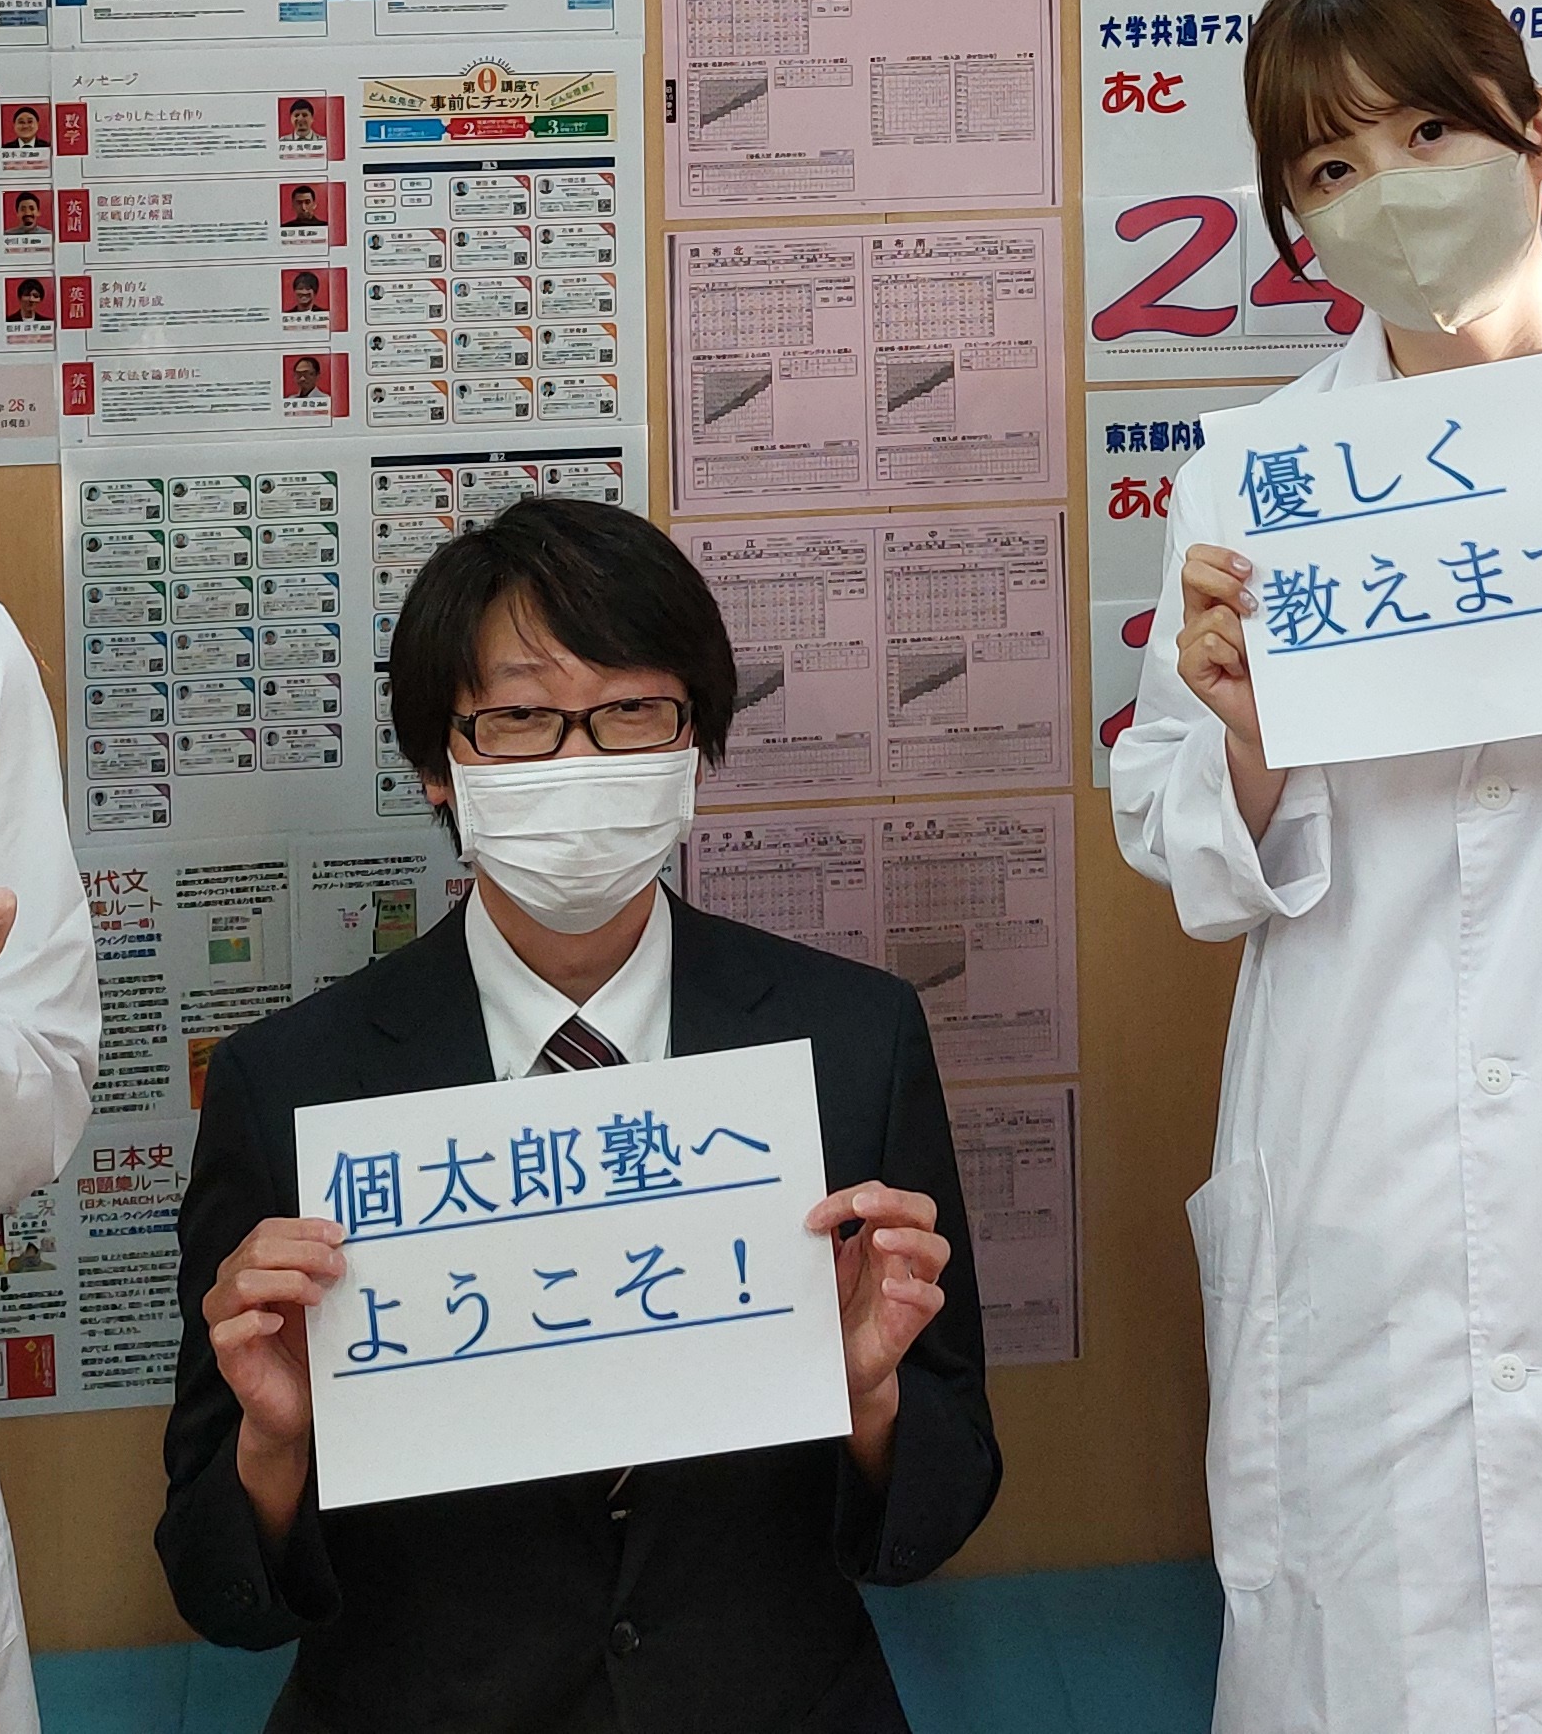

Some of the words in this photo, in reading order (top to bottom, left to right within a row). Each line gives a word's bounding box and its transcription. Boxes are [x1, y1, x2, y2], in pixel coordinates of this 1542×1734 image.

[72, 72, 139, 87] メッセージ
[1101, 71, 1187, 114] あと
[63, 113, 81, 146] 数学
[66, 199, 83, 233] 英語
[68, 286, 85, 320] 英語
[71, 372, 87, 406] 英語
[1238, 418, 1476, 529] 優しく
[93, 1142, 175, 1173] 日本史
[324, 1109, 771, 1235] 個太郎塾へ
[77, 1170, 188, 1195] 問題集ルート
[346, 1238, 753, 1364] ようこそ！
